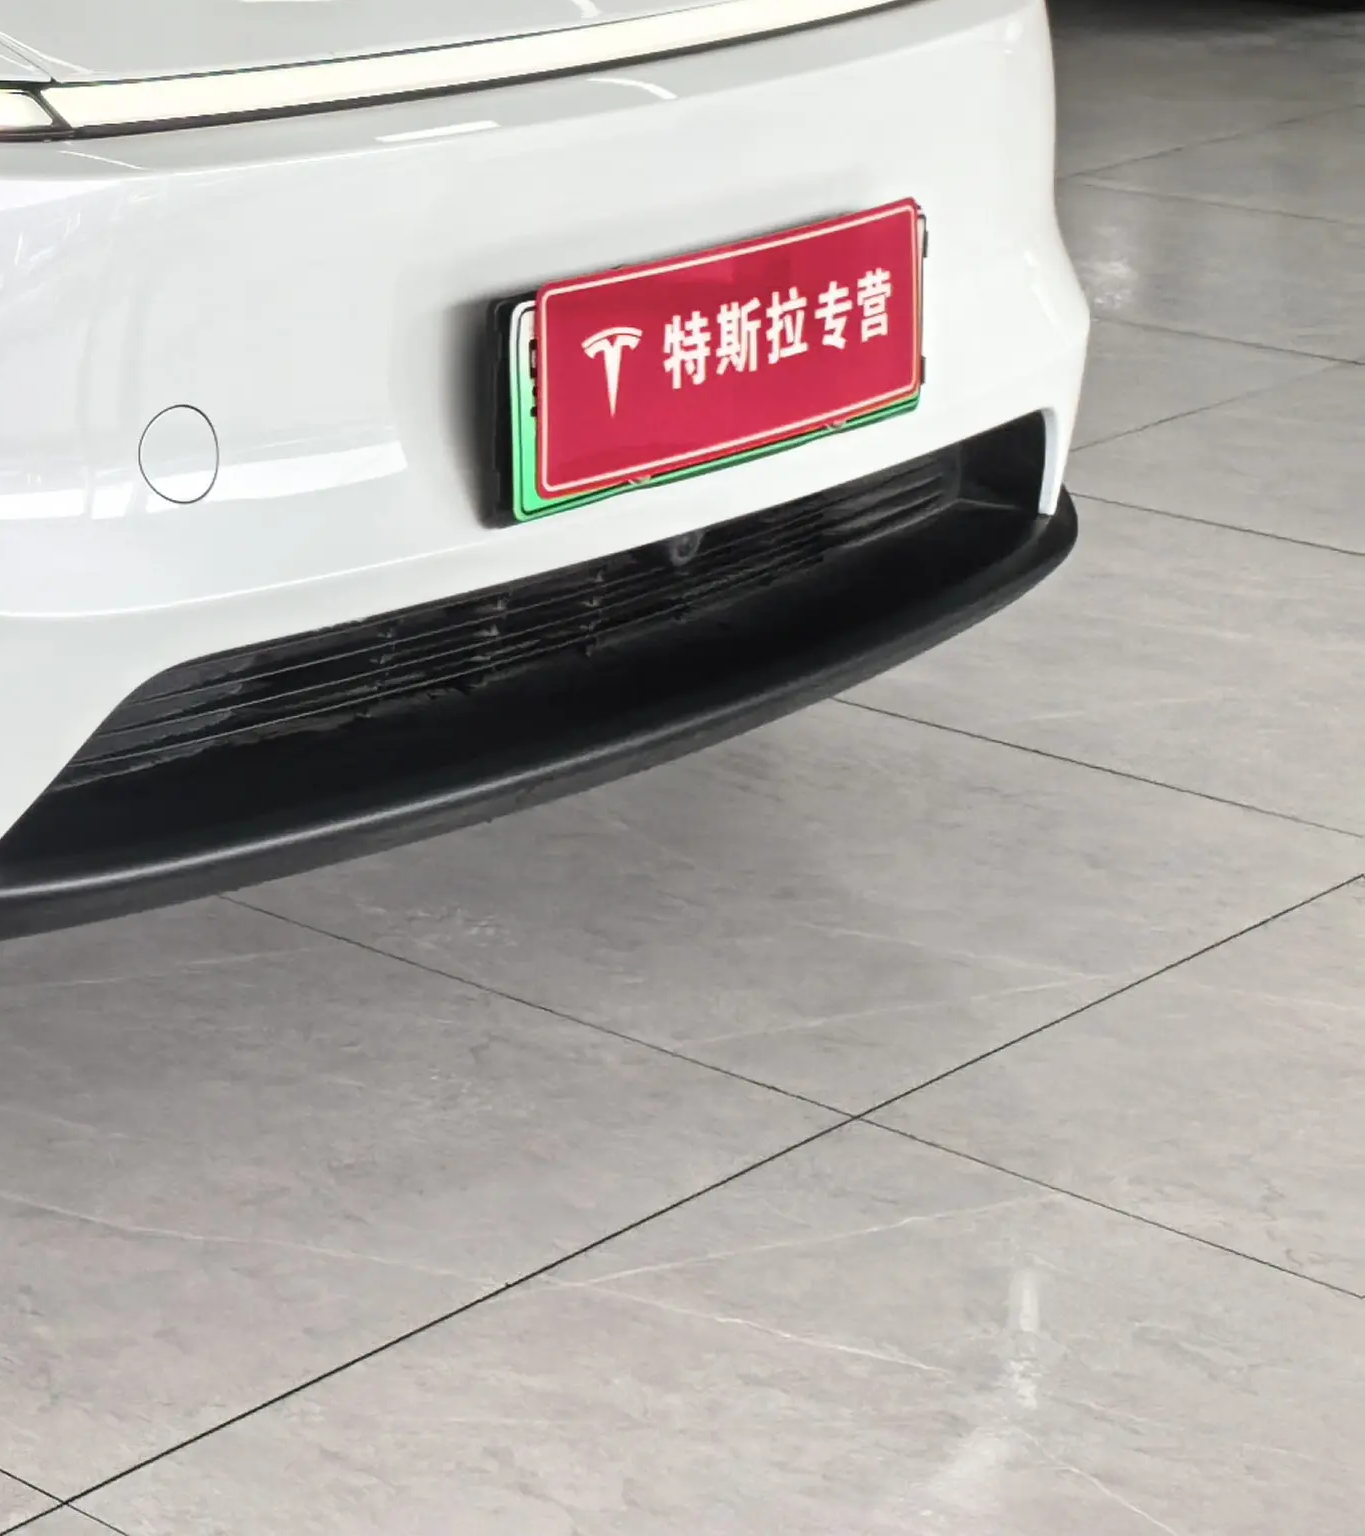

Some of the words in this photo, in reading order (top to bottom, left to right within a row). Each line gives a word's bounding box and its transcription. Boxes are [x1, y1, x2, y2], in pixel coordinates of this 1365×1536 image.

[663, 267, 893, 390] 特斯拉专营
